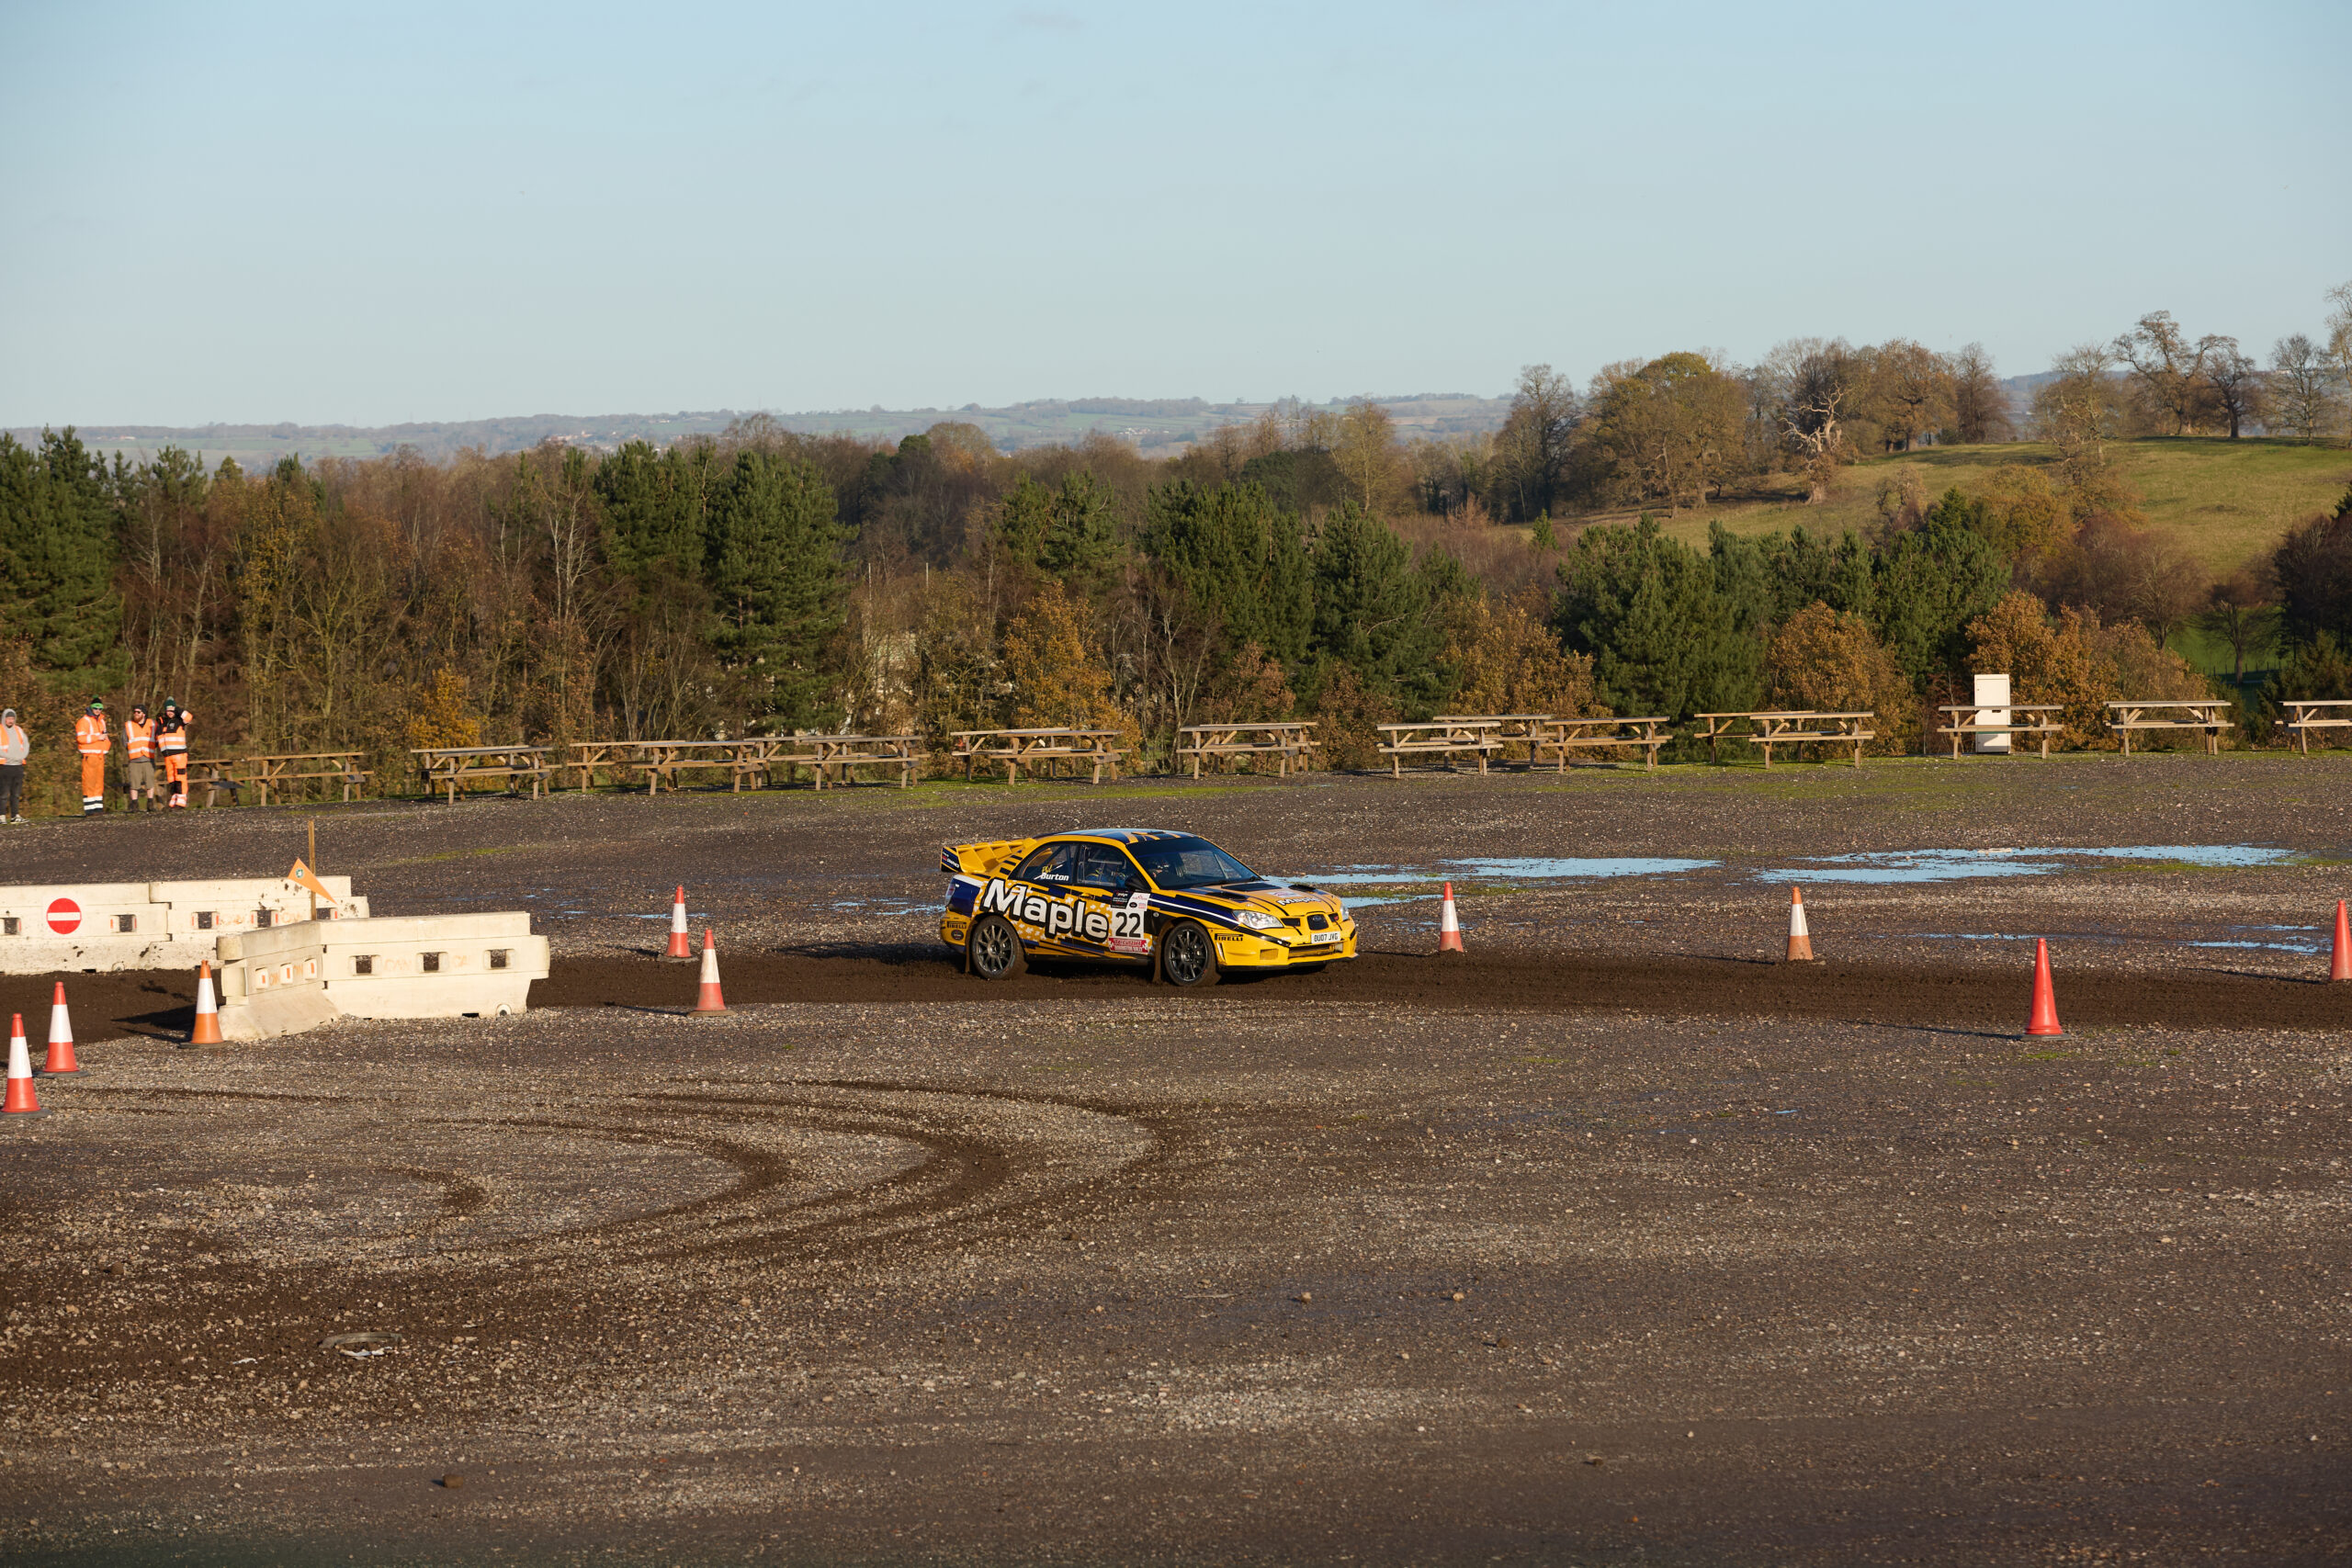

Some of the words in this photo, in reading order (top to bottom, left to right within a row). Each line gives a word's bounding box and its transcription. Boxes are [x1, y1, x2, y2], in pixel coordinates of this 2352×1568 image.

[1039, 872, 1069, 882] Burton
[980, 877, 1109, 942] Maple
[1115, 911, 1141, 938] 22
[1215, 933, 1244, 942] PIRELLI
